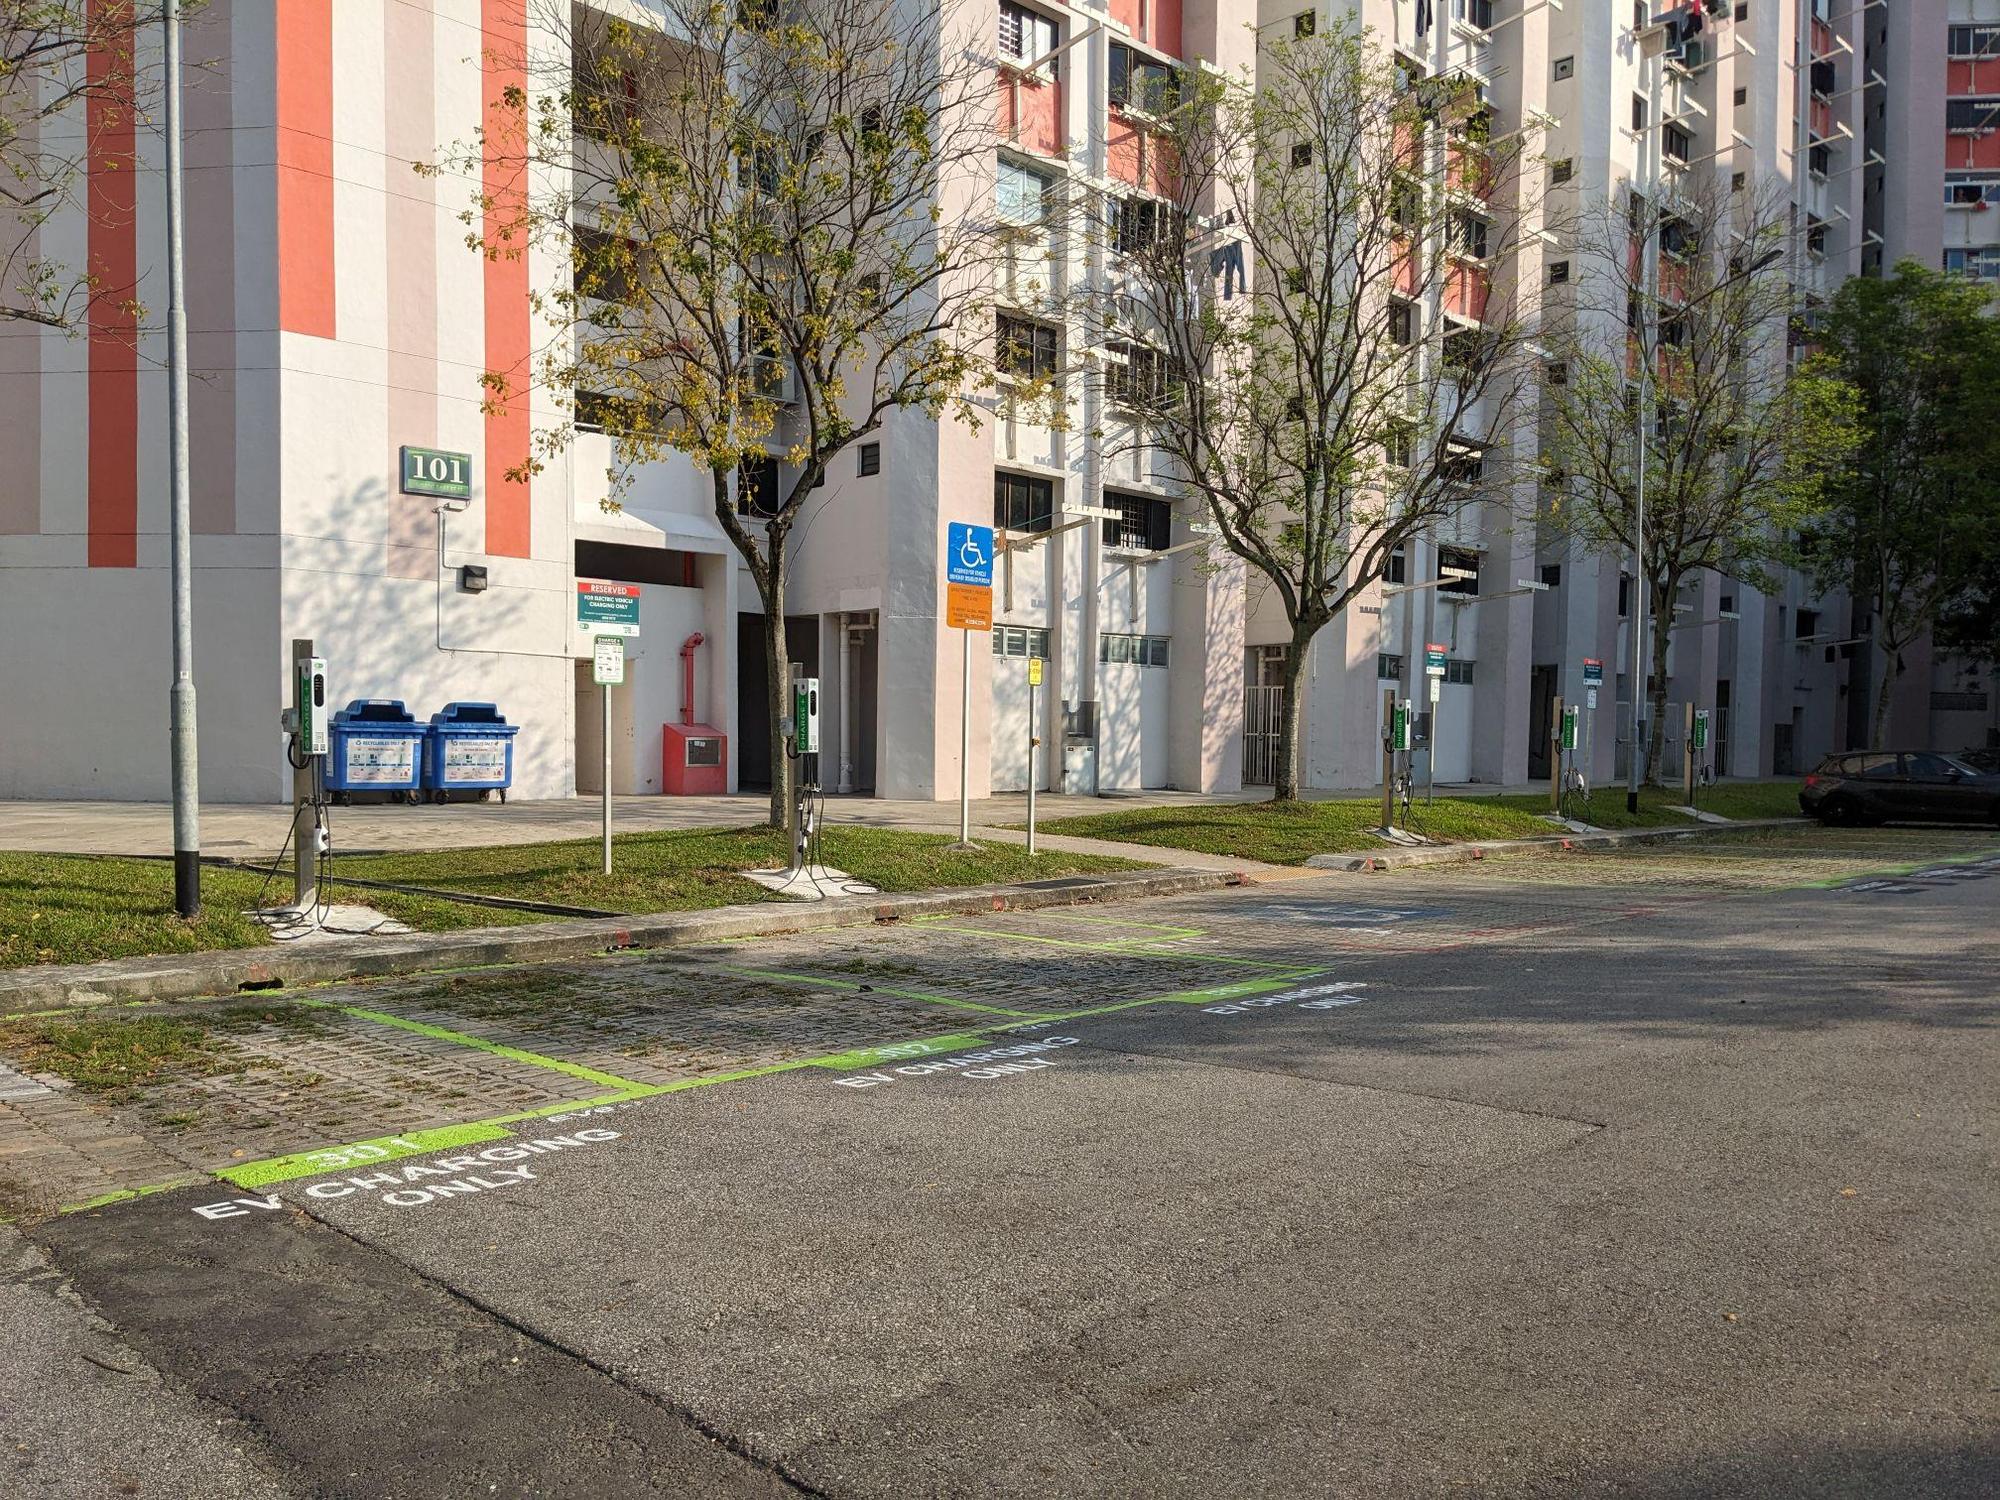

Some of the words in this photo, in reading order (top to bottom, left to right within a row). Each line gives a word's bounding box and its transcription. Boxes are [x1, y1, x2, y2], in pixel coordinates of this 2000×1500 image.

[413, 455, 464, 484] 101
[591, 584, 628, 595] RESERVED
[1200, 1004, 1250, 1015] EV
[832, 1071, 895, 1088] EV
[895, 1036, 1081, 1076] CHARGING
[961, 1057, 1059, 1079] ONLY
[306, 1138, 421, 1167] 301
[191, 1193, 283, 1220] EV
[305, 1129, 623, 1199] CHARGING
[382, 1164, 538, 1207] ONLY
